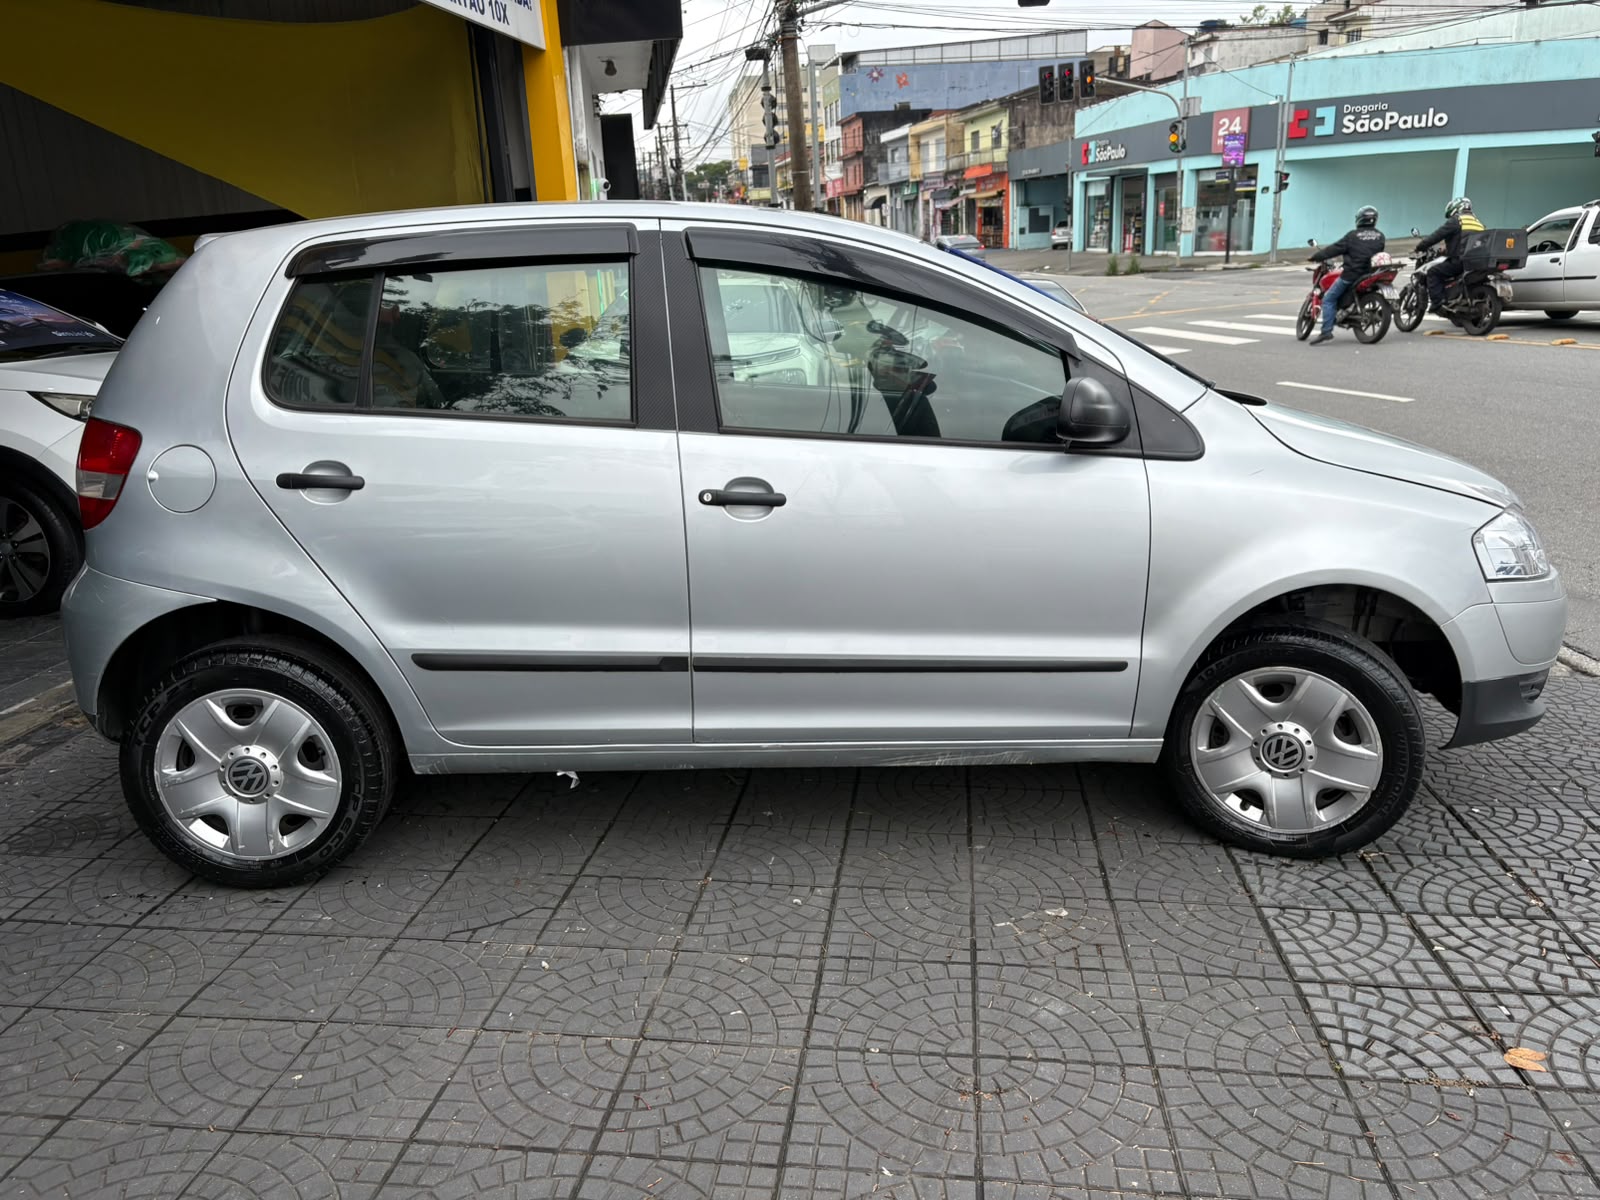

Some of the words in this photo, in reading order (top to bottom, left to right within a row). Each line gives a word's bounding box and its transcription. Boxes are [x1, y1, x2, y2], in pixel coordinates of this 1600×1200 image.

[488, 0, 510, 26] 10X
[1343, 102, 1389, 114] Drogaria
[1217, 116, 1242, 137] 24
